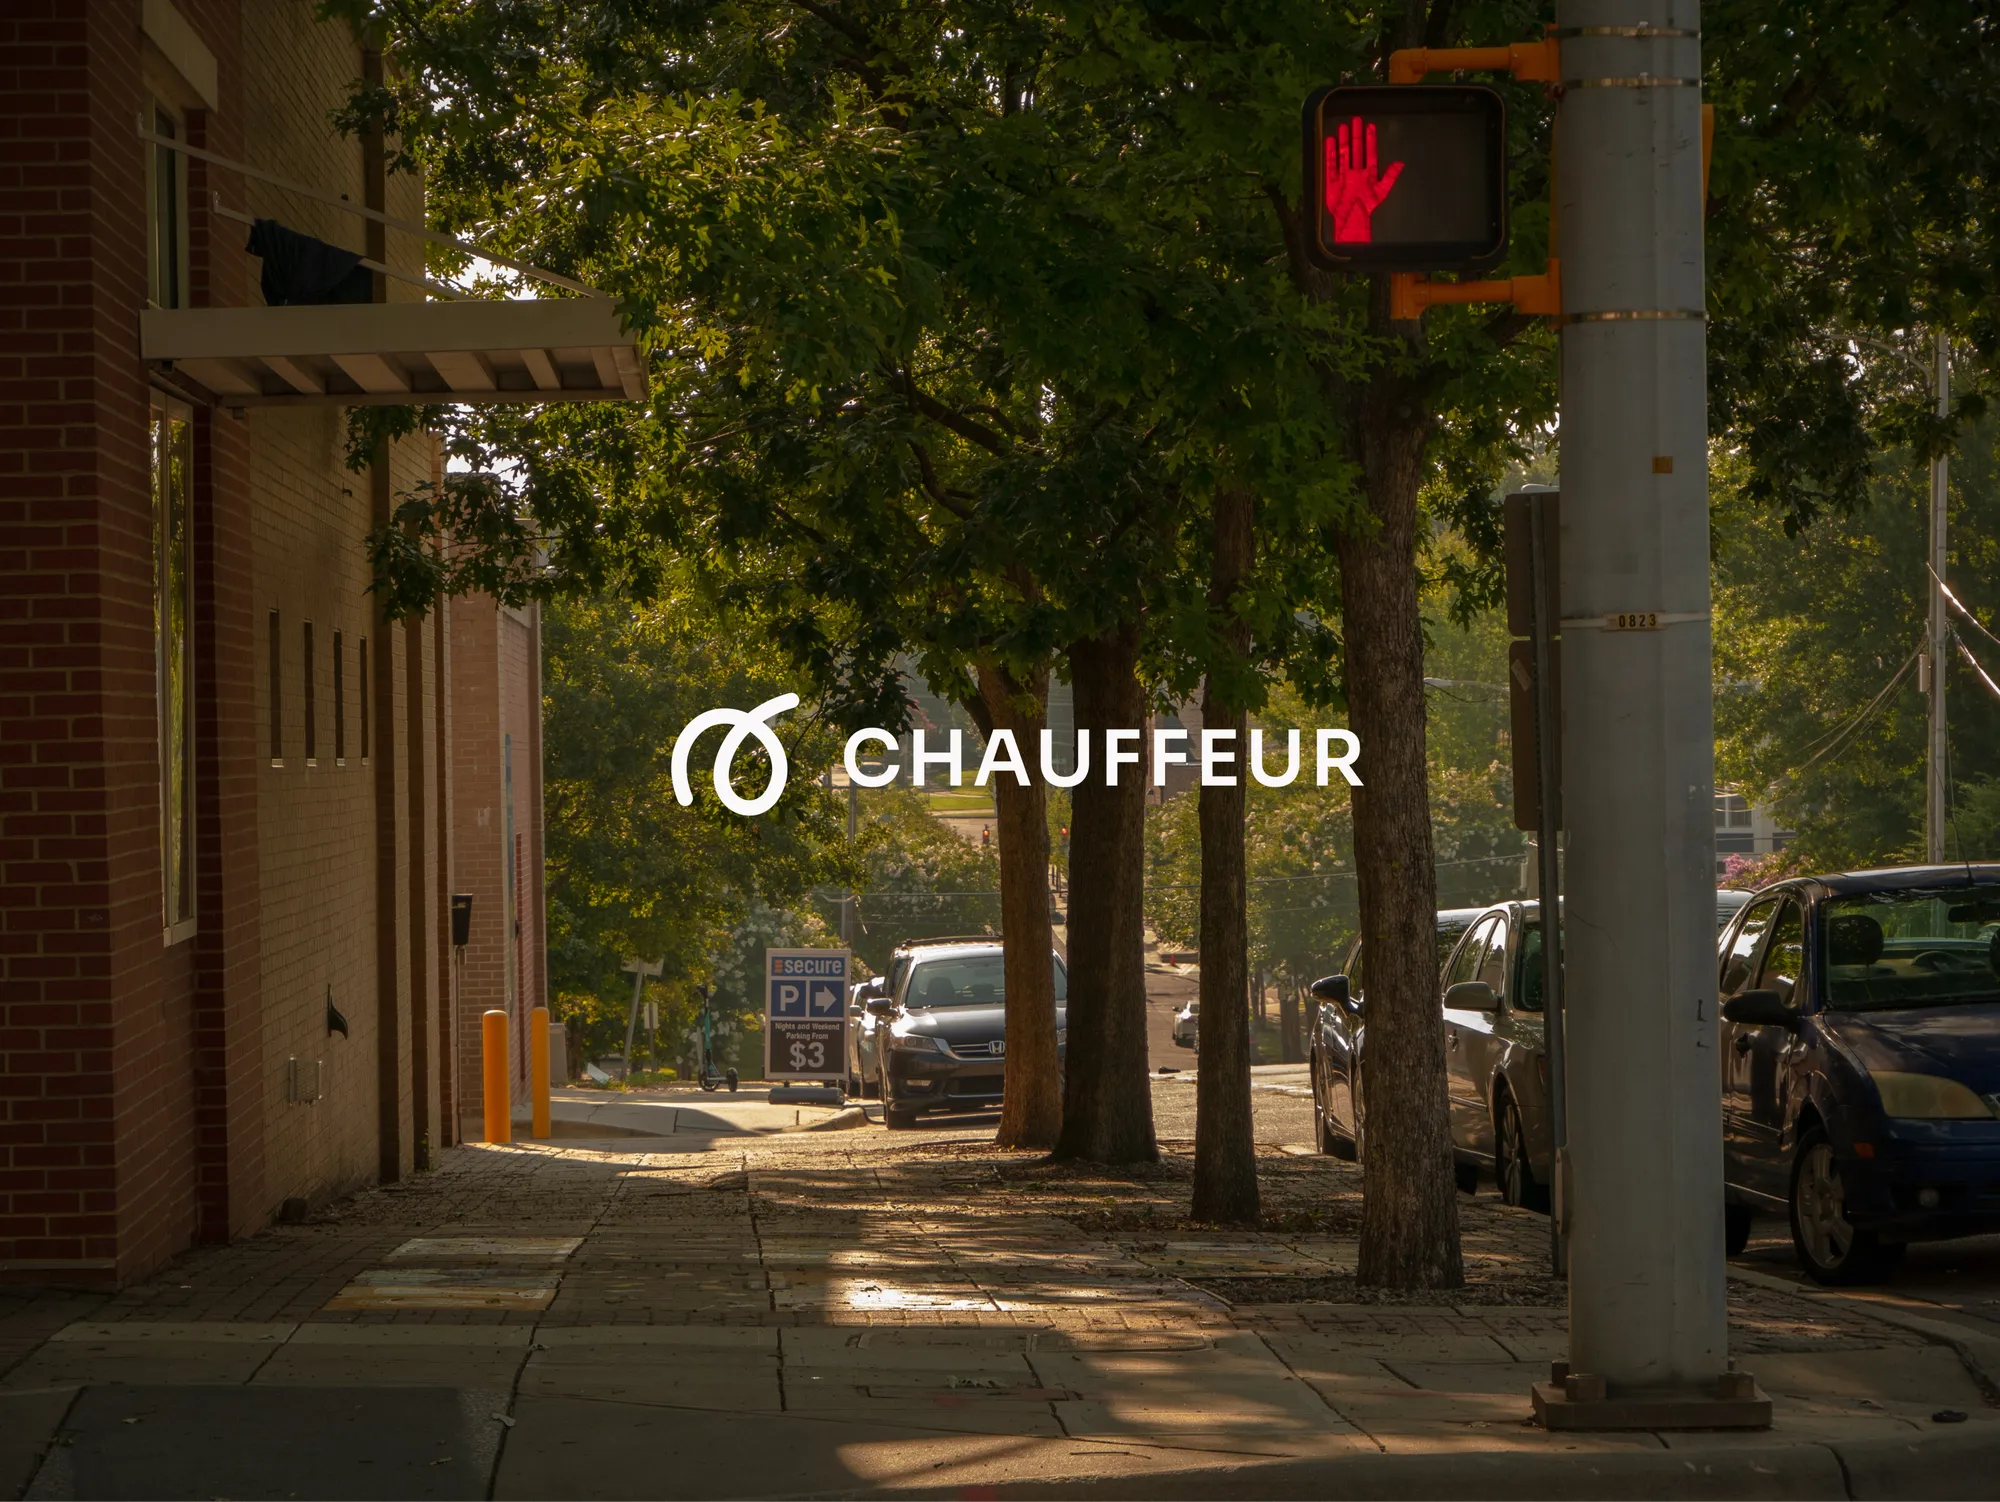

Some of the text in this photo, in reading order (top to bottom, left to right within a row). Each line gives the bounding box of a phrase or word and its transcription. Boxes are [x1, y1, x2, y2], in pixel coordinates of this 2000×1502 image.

[1618, 613, 1657, 628] 0823
[784, 959, 842, 974] secure
[780, 985, 800, 1012] P
[774, 1022, 840, 1031] Nights and Weekend
[785, 1032, 829, 1041] Parking From
[789, 1041, 825, 1071] $3
